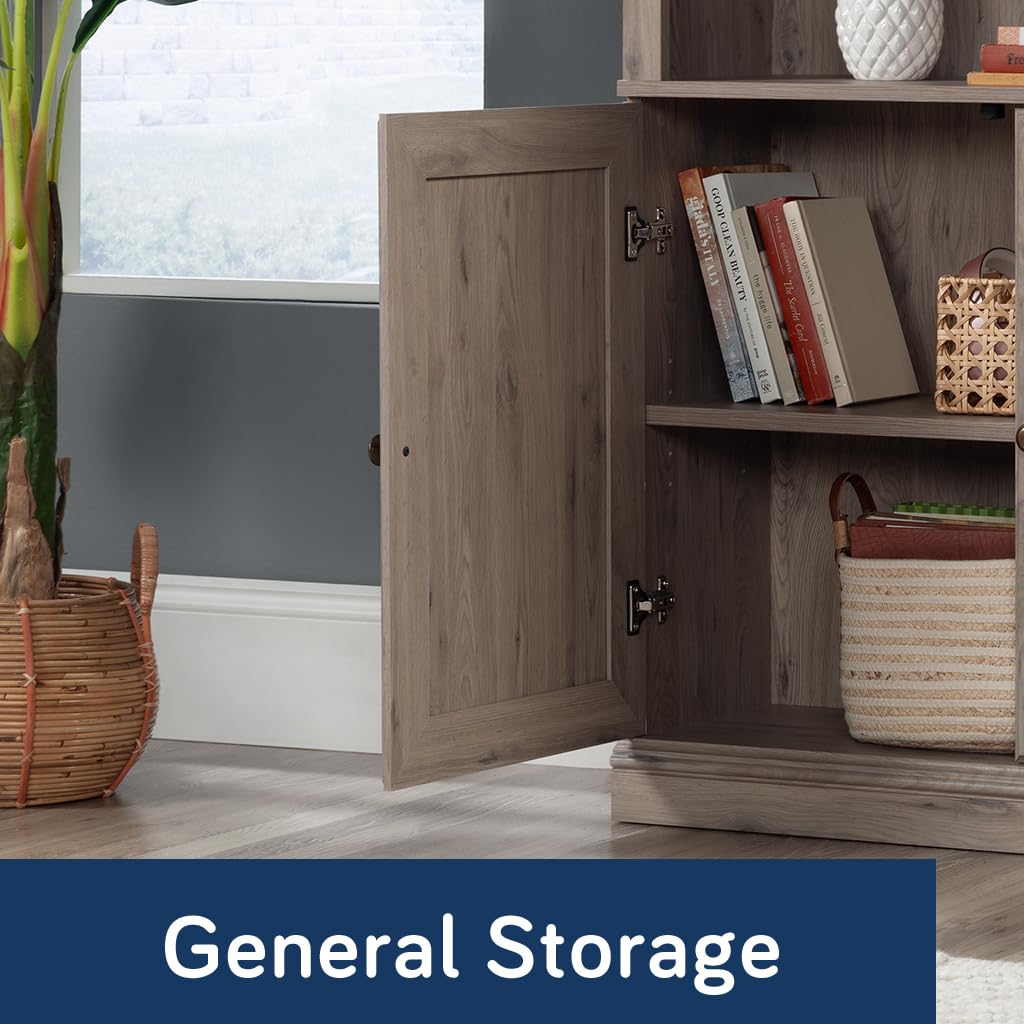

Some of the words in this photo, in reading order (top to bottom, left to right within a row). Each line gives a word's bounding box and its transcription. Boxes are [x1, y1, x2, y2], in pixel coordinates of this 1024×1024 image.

[711, 187, 725, 219] GOOP
[720, 221, 736, 257] CLEAN
[730, 260, 748, 301] BEAUTY
[703, 249, 720, 287] ITALY
[802, 261, 816, 296] QUESTION
[753, 273, 761, 288] the
[757, 289, 768, 314] hygge
[764, 315, 772, 330] life
[784, 279, 794, 295] The
[787, 296, 800, 321] Scarlet
[795, 323, 808, 343] Cord
